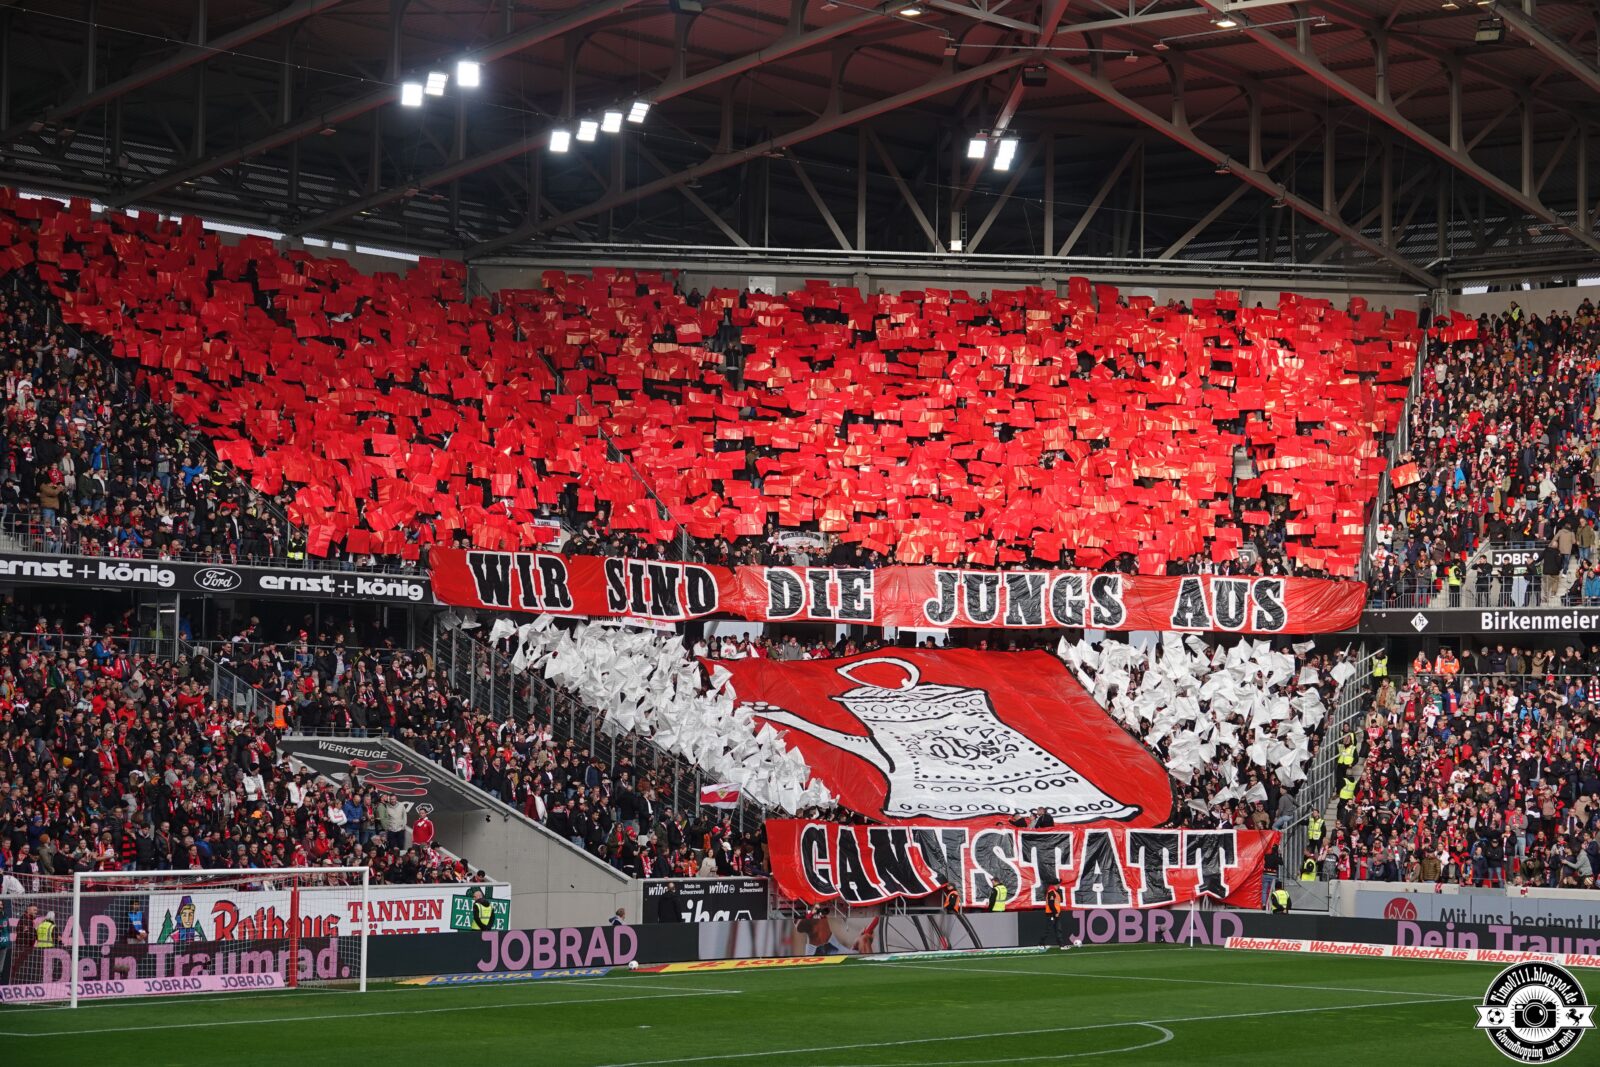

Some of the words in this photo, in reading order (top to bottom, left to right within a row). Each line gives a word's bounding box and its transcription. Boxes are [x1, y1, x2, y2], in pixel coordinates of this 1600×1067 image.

[98, 562, 176, 587] könig
[202, 570, 234, 588] Ford
[259, 575, 335, 593] ernst
[356, 577, 424, 601] könig
[466, 551, 573, 611] WIR
[604, 557, 719, 620] SIND
[764, 567, 874, 622] DIE
[923, 569, 1127, 627] JUNGS
[1171, 576, 1288, 634] AUS
[1481, 611, 1600, 630] Birkenmeier
[318, 741, 389, 759] WERKZEUGE
[801, 822, 1238, 910] CANNSTATT
[709, 882, 728, 894] wiha
[347, 899, 444, 922] TANNEN
[455, 898, 507, 915] TAEN
[1439, 908, 1466, 923] Mit
[1069, 909, 1243, 946] JOBRAD
[1396, 921, 1478, 950] Dein
[477, 925, 638, 972] JOBRAD
[1229, 937, 1303, 951] WeberHaus
[1309, 941, 1384, 956] WeberHaus
[1391, 946, 1468, 961] WeberHaus
[42, 946, 137, 983] Dein
[144, 977, 203, 992] JOBRAD
[220, 975, 275, 989] JOBRAD
